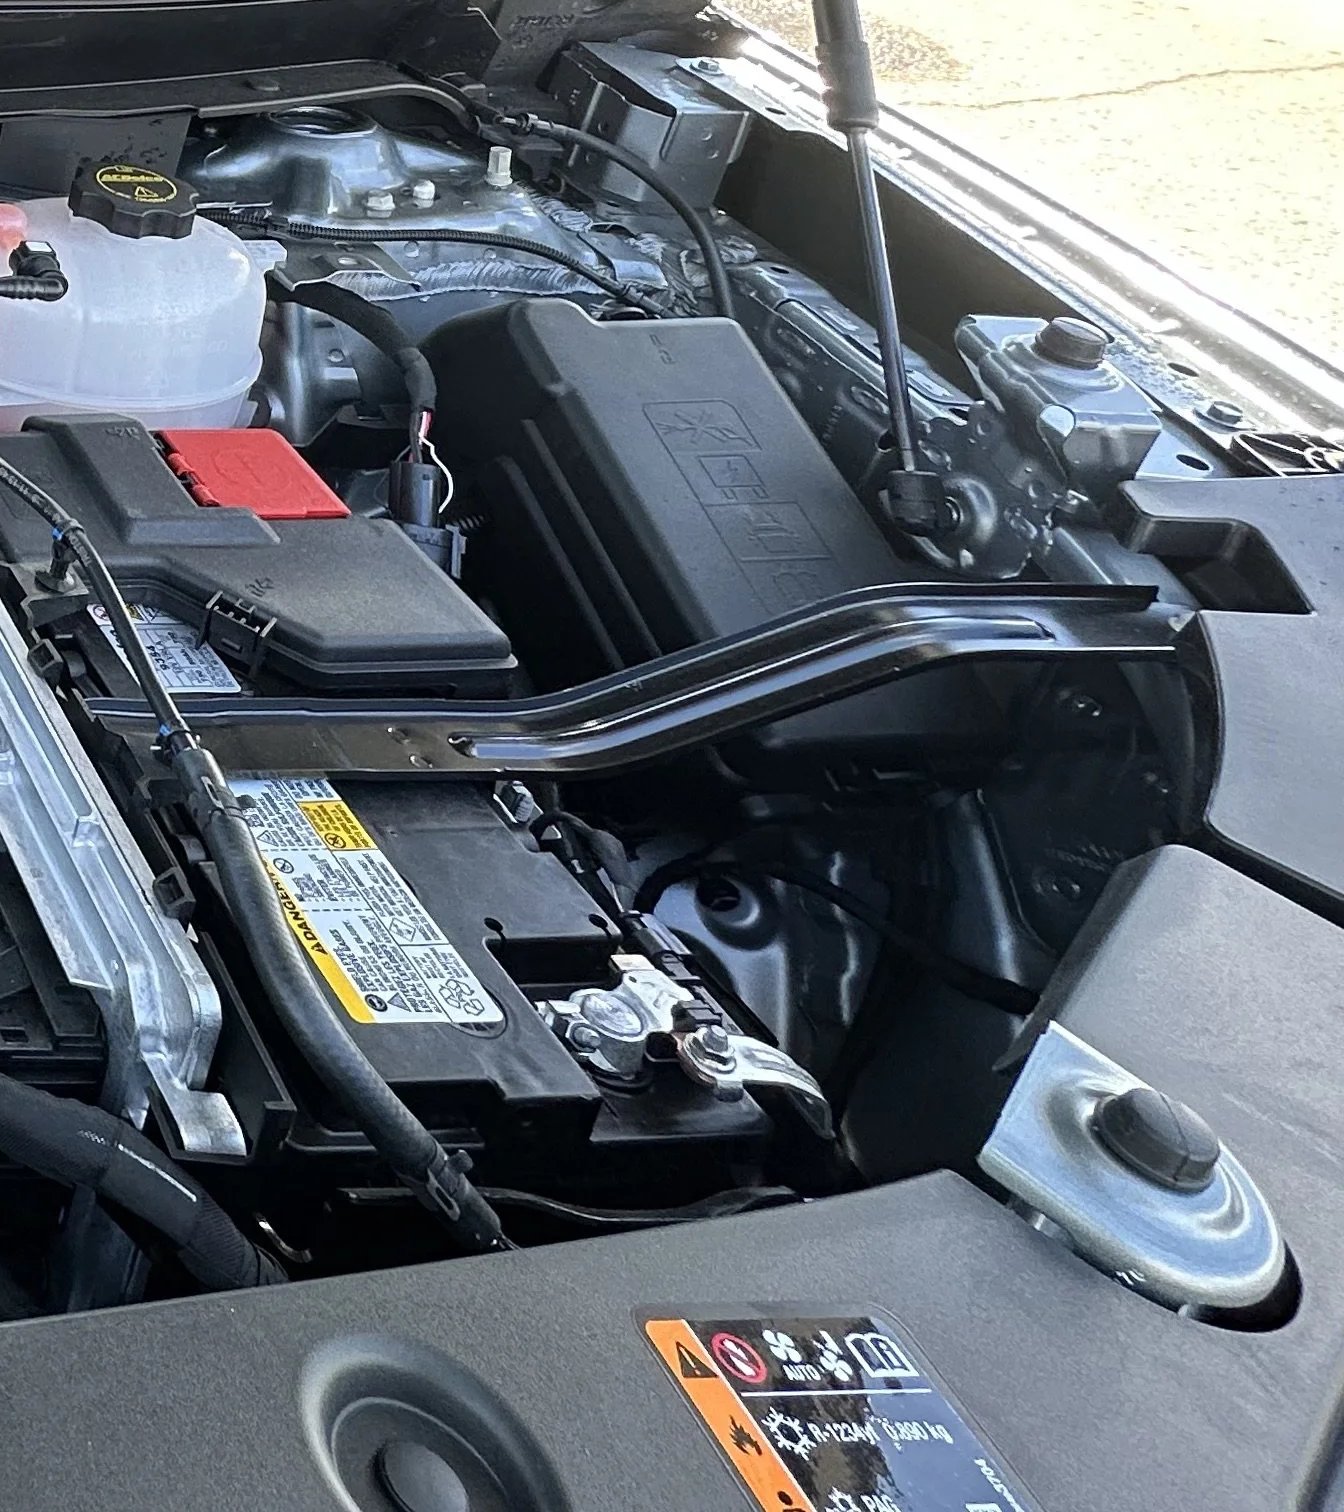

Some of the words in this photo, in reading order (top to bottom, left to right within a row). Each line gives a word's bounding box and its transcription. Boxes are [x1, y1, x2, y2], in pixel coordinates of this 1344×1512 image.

[782, 1364, 821, 1382] AUTO
[807, 1422, 881, 1445] R-1234yf
[923, 1421, 954, 1445] kg
